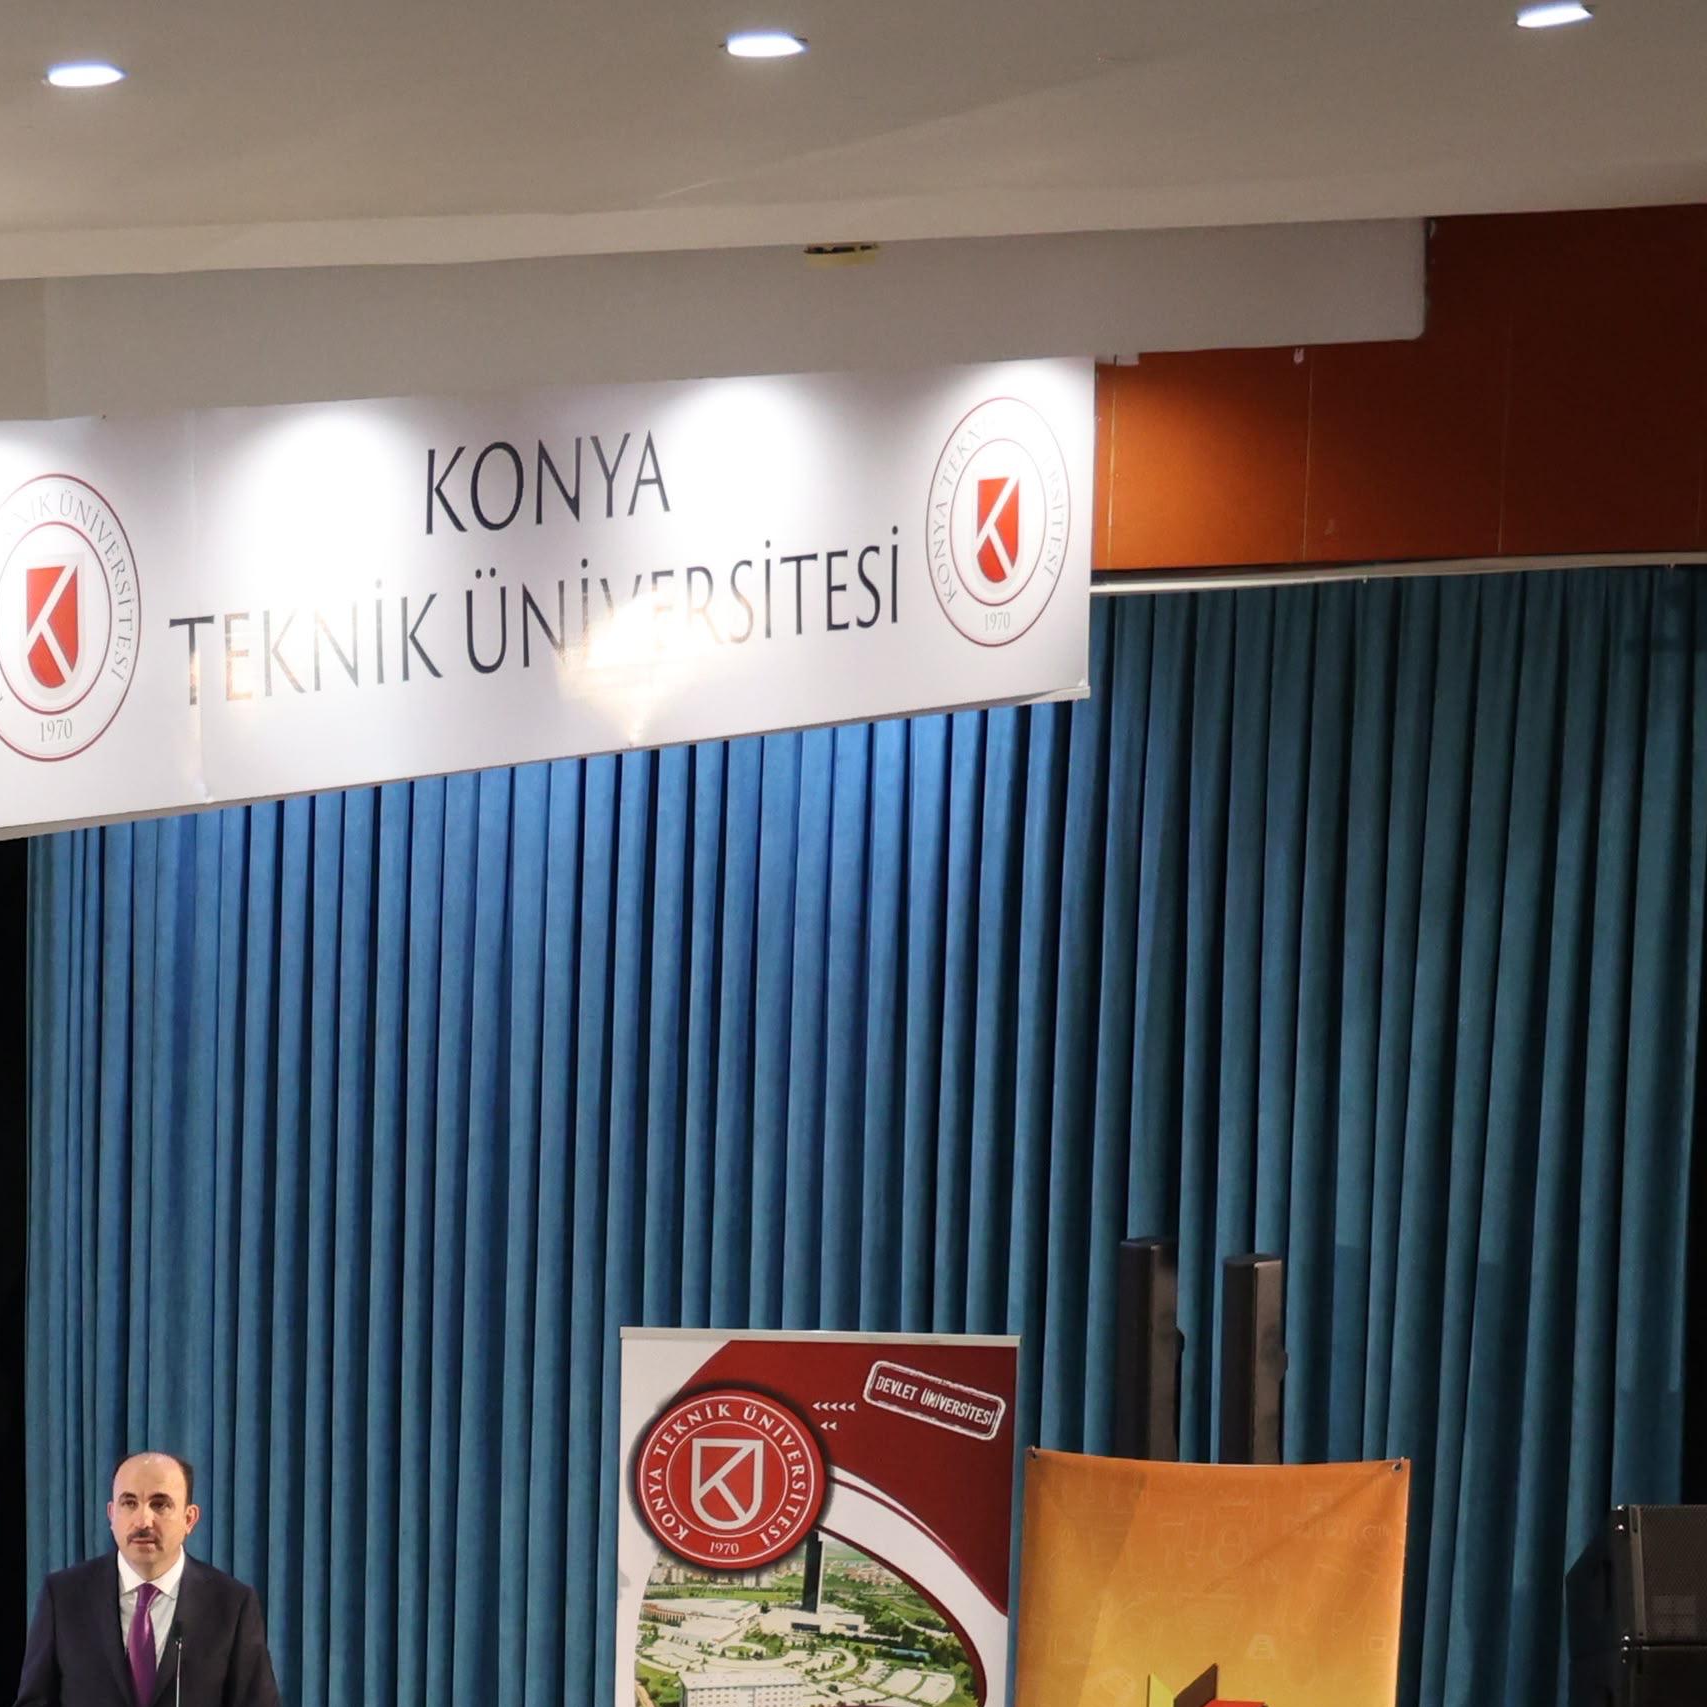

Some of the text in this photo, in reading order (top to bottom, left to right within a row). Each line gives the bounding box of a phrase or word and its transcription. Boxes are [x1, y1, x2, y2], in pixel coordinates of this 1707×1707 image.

[425, 430, 671, 536] KONYA
[984, 612, 1011, 633] 1970
[169, 579, 444, 706] TEKNİK
[39, 718, 73, 743] 1970
[875, 1375, 918, 1401] DEVLET
[648, 1402, 807, 1547] KONYA TEKNİK ÜNİVERSİTESİ
[709, 1541, 740, 1555] 1970
